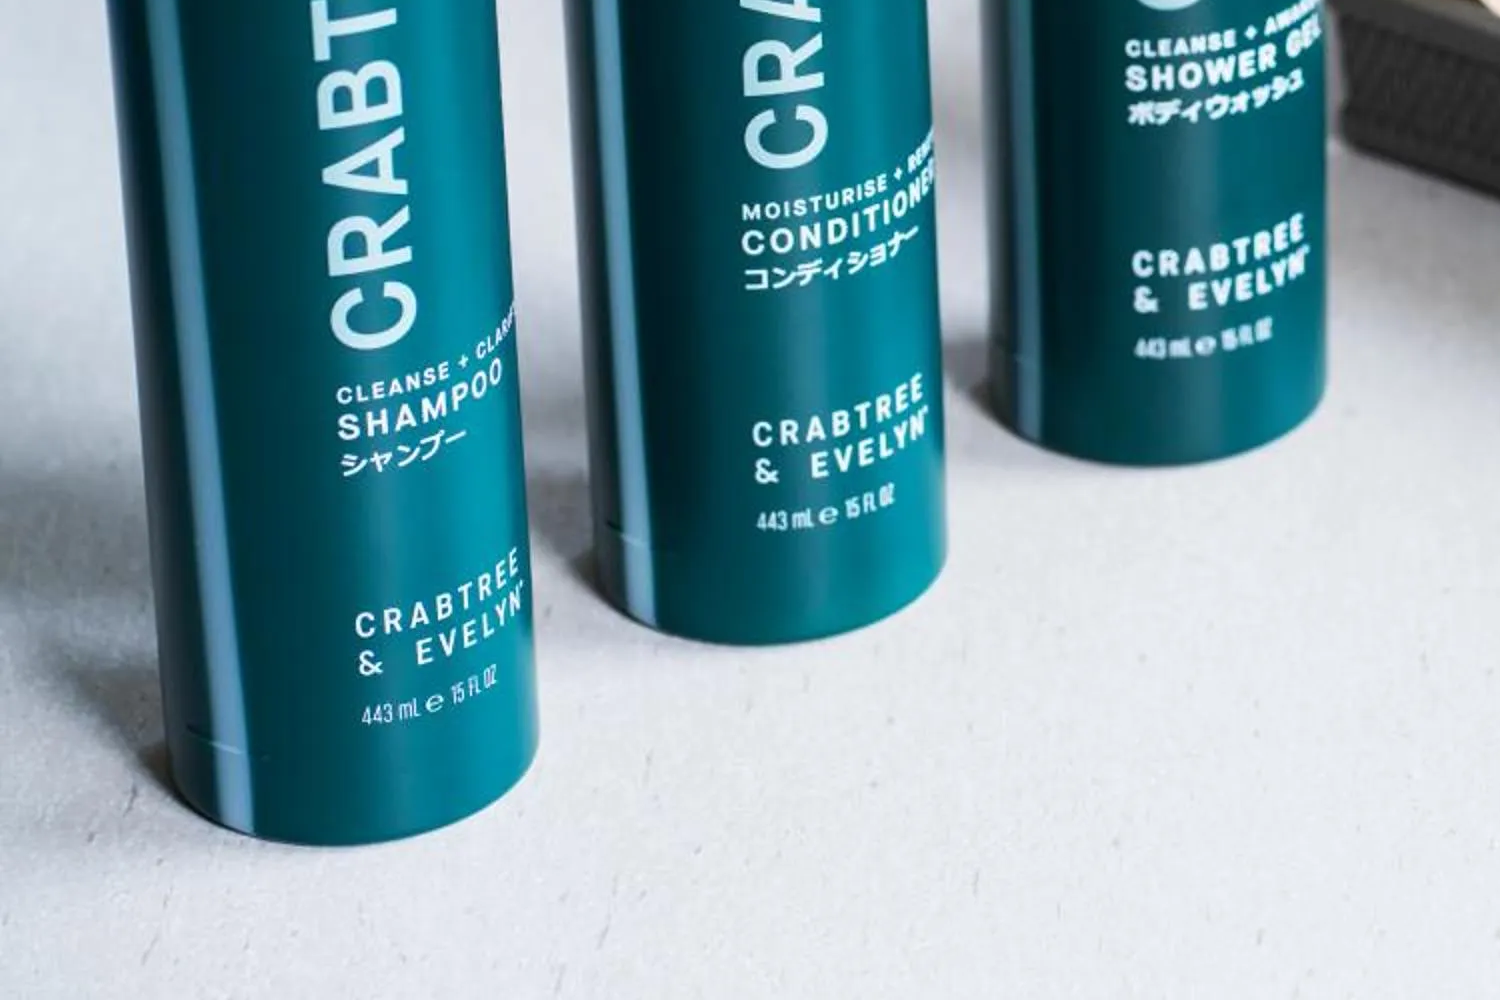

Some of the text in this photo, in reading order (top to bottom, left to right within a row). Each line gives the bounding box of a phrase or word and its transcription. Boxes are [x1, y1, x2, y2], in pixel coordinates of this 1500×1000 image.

[1125, 29, 1236, 58] CLEANSE
[1125, 43, 1277, 92] SHOWER
[741, 156, 934, 256] CONDITIONER
[742, 173, 887, 221] MOISTURISE
[744, 226, 919, 291] コンディショナー
[1132, 212, 1304, 278] CRABTREE
[1133, 285, 1160, 314] &
[337, 361, 449, 405] CLEANSE
[338, 357, 502, 440] SHAMPOO
[752, 373, 924, 448] CRABTREE
[340, 429, 467, 477] シャンプー
[755, 458, 779, 484] &
[757, 510, 787, 531] 443
[355, 547, 518, 639] CRABTREE
[359, 650, 382, 676] &
[361, 703, 393, 726] 443
[399, 697, 419, 719] mL
[451, 681, 465, 704] 15
[468, 673, 482, 698] FL
